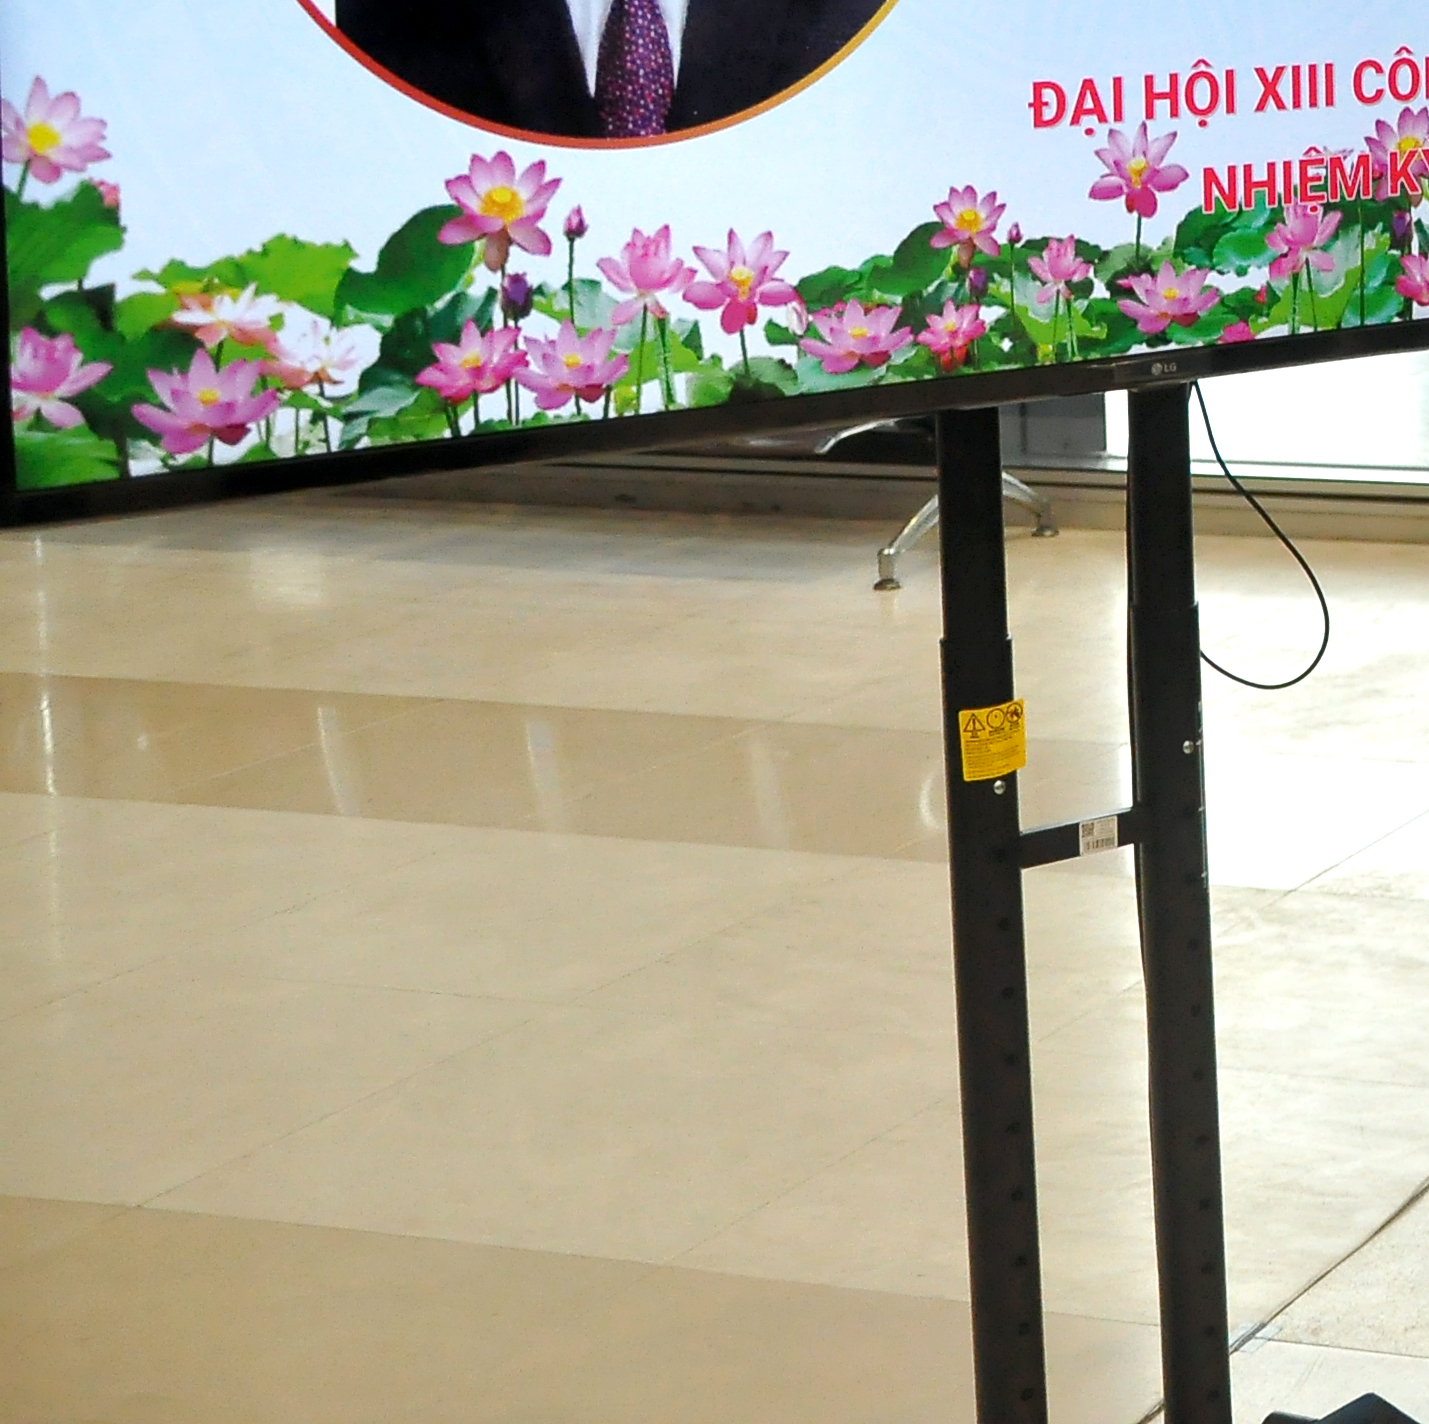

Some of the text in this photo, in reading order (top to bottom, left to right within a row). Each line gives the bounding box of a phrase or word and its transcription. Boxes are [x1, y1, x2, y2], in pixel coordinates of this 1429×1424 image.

[1028, 76, 1124, 136] ĐẠI
[1144, 57, 1236, 128] HỘI
[1254, 62, 1335, 113] XIII
[1202, 145, 1373, 214] NHIỆM
